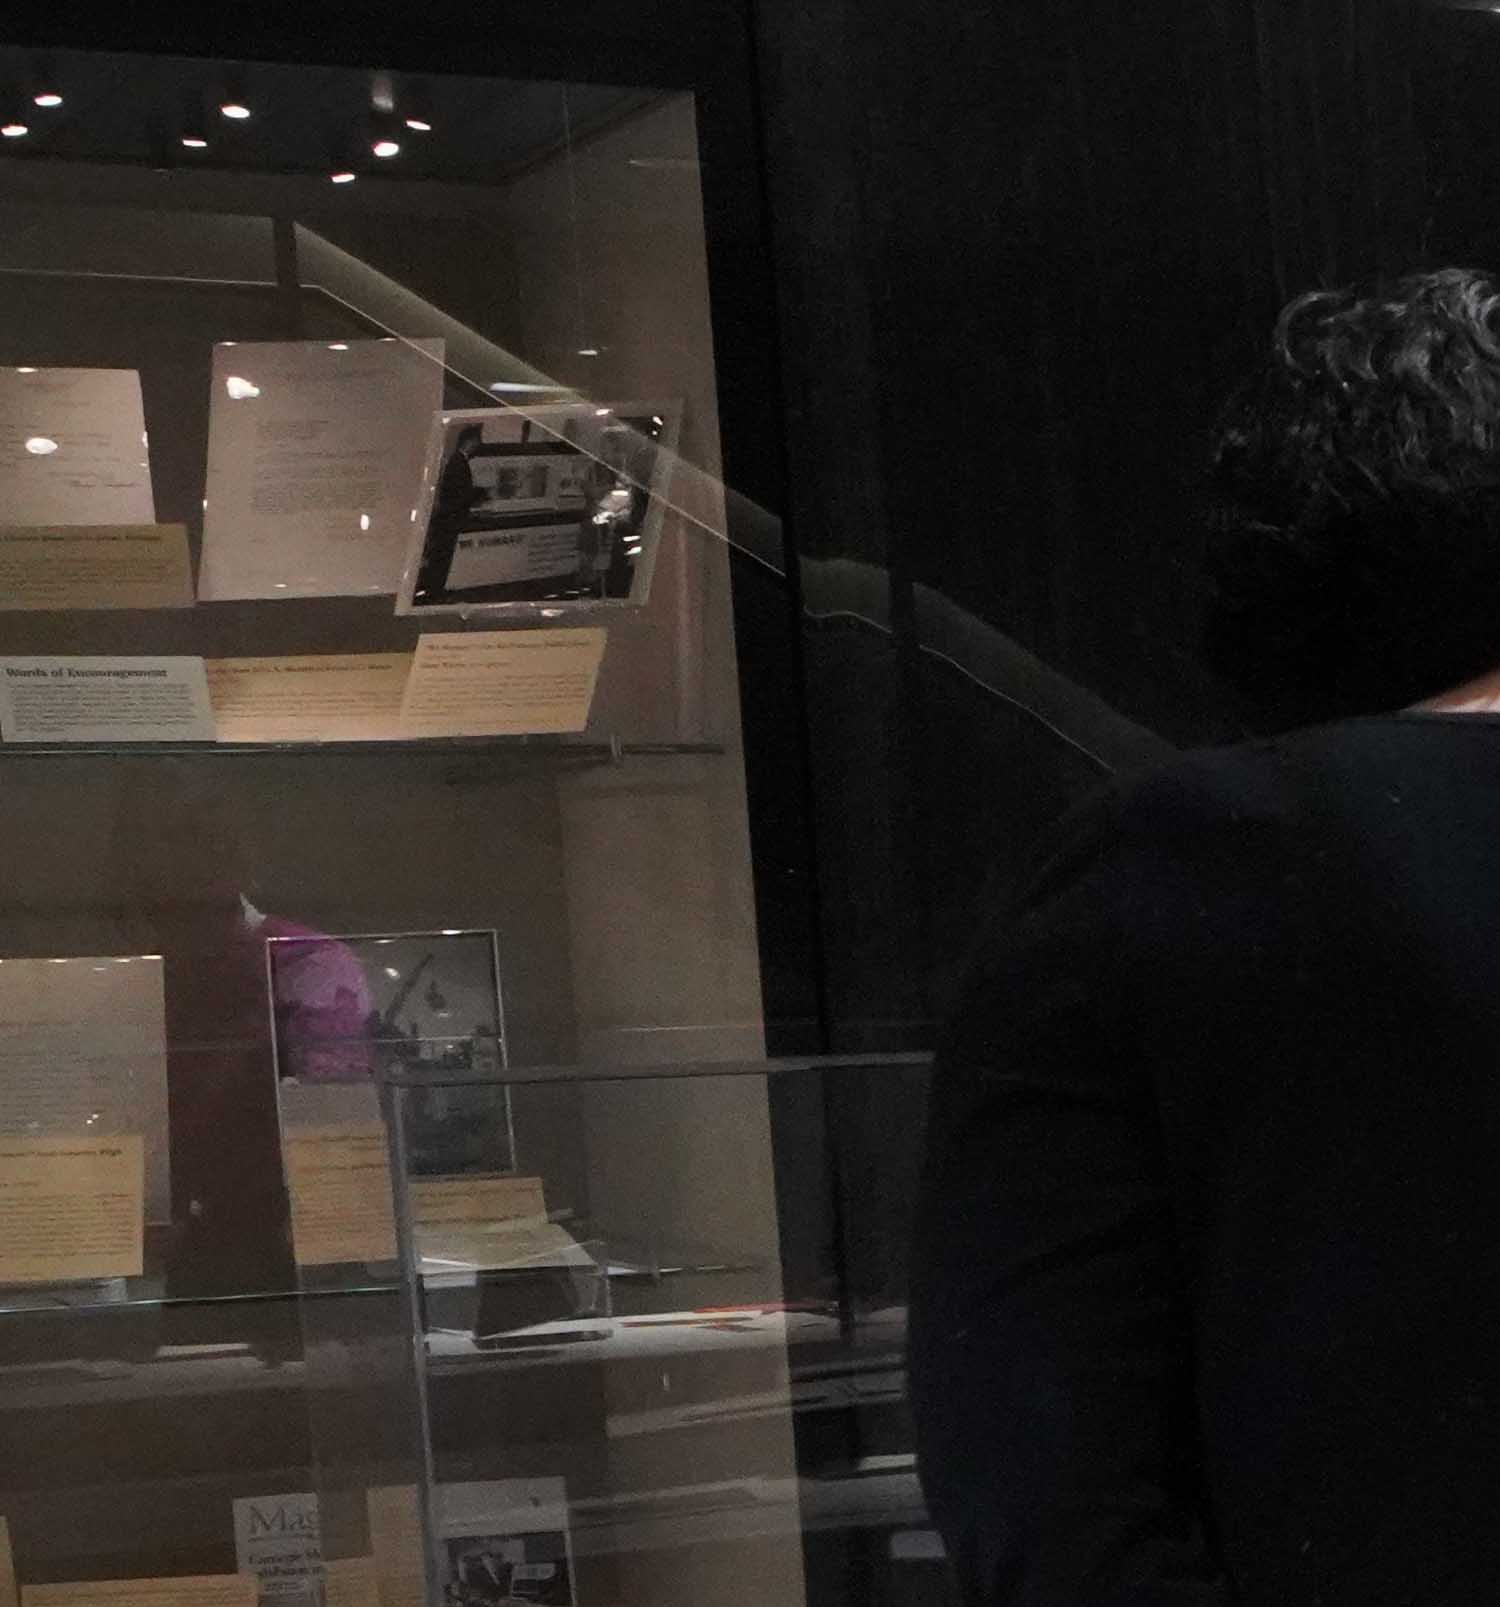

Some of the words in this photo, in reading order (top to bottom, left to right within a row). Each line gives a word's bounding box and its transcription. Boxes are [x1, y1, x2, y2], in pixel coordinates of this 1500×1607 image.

[5, 668, 49, 679] Words
[50, 667, 64, 679] of
[67, 668, 168, 681] Encouragement
